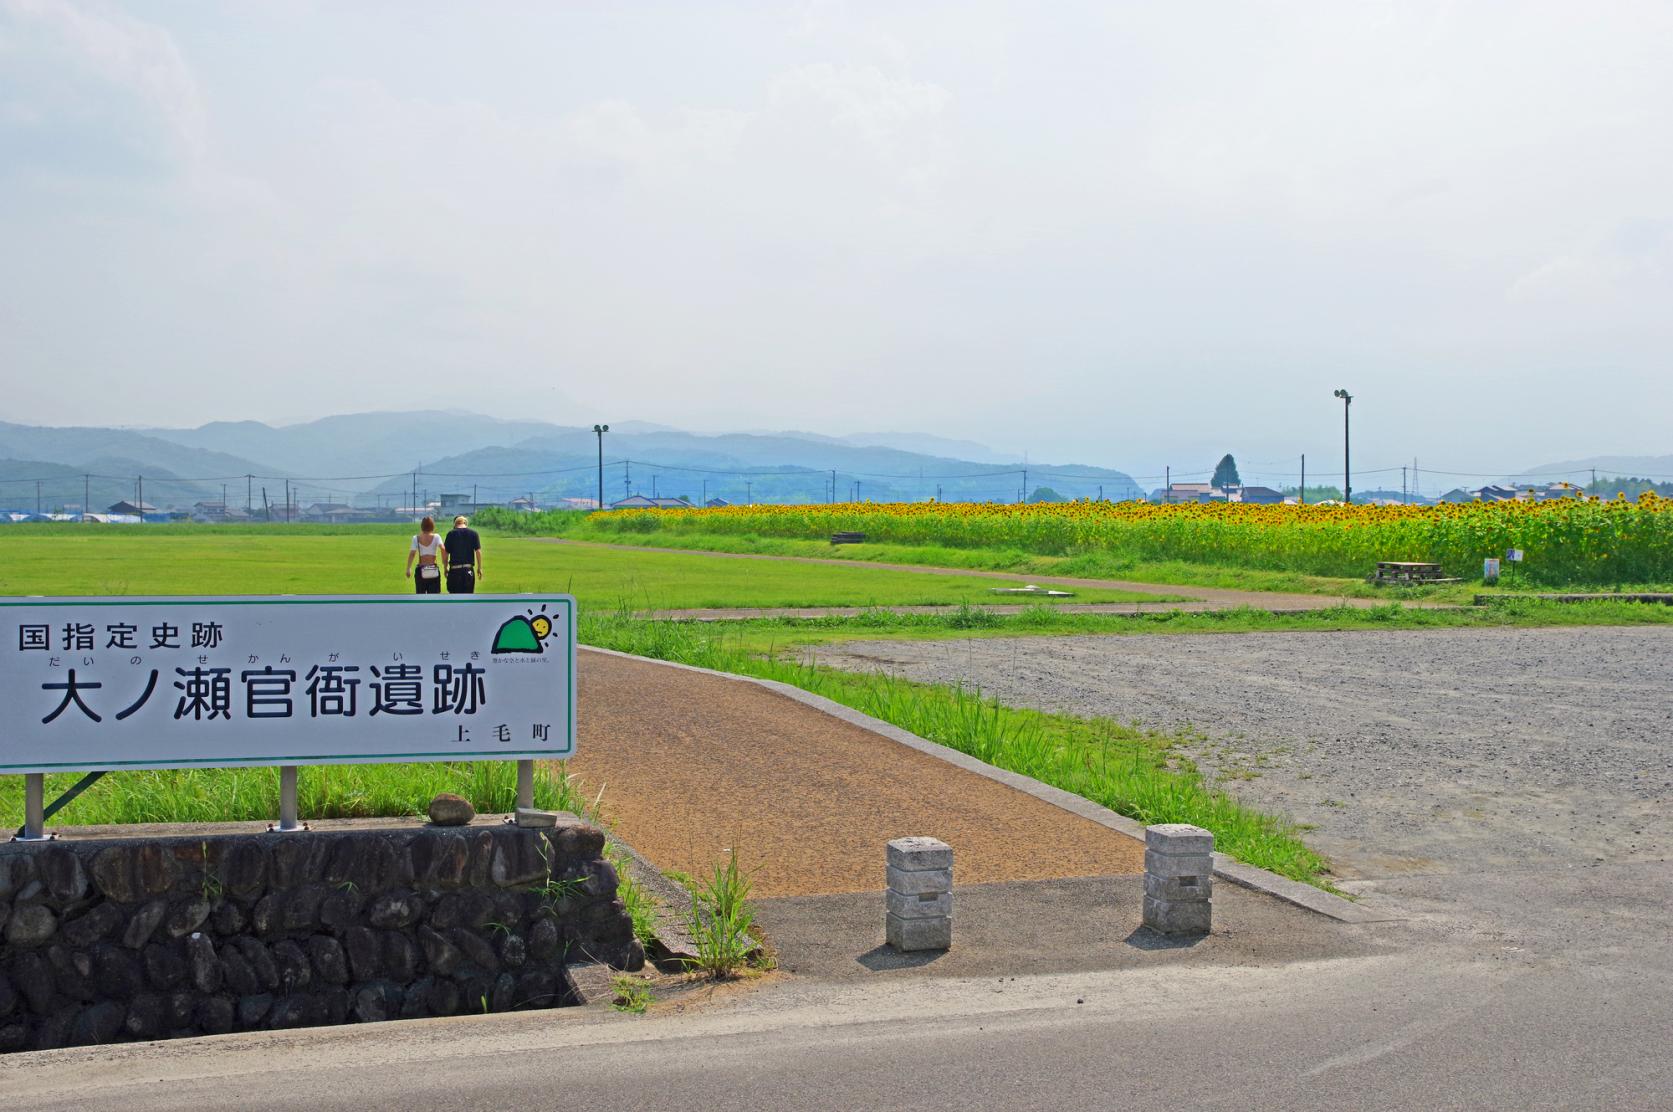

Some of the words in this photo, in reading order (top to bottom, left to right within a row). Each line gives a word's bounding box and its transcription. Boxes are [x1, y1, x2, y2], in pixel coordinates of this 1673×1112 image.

[19, 622, 223, 650] 国指定史跡
[42, 662, 486, 724] 大ノ瀬官衙遺跡
[451, 723, 551, 742] 上毛町
